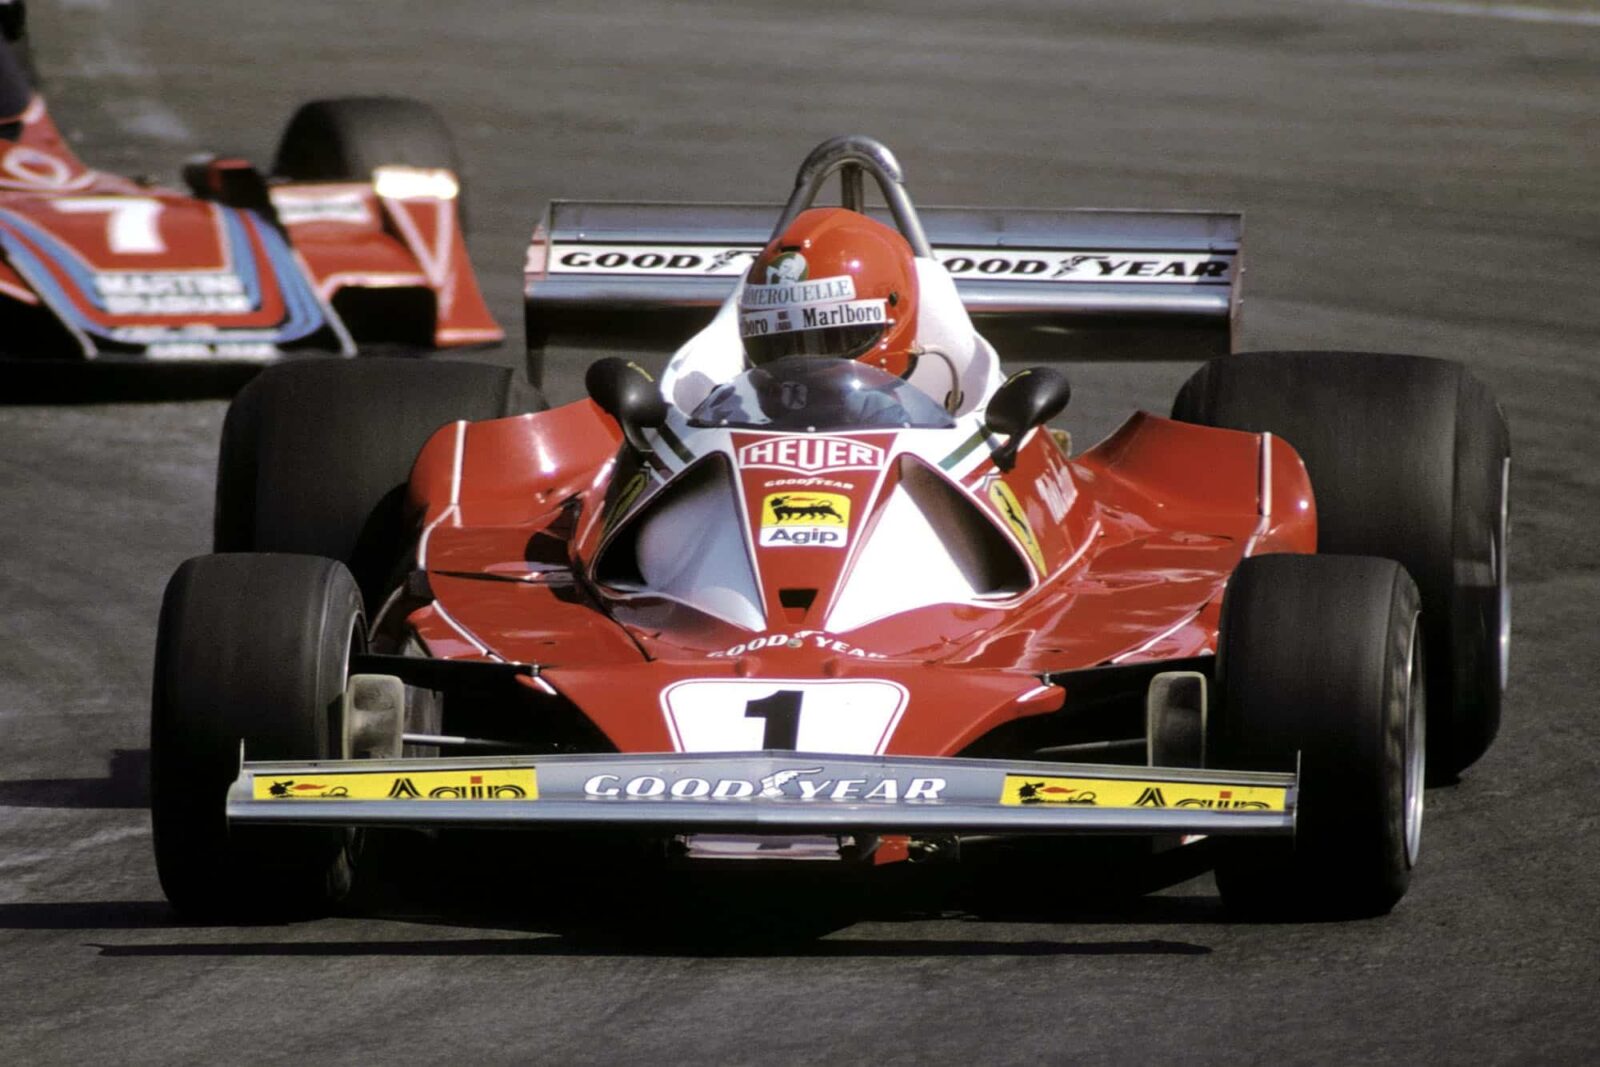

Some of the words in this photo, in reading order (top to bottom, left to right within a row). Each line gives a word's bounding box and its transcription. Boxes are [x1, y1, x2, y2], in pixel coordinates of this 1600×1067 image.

[54, 199, 165, 253] 7
[560, 252, 702, 269] GOOD
[1096, 260, 1229, 277] YEAR
[802, 304, 882, 328] Marlboro
[750, 439, 873, 470] HEUER
[768, 528, 839, 545] Agip
[744, 689, 804, 751] 1
[584, 774, 754, 797] GOOD
[799, 775, 946, 799] YEAR
